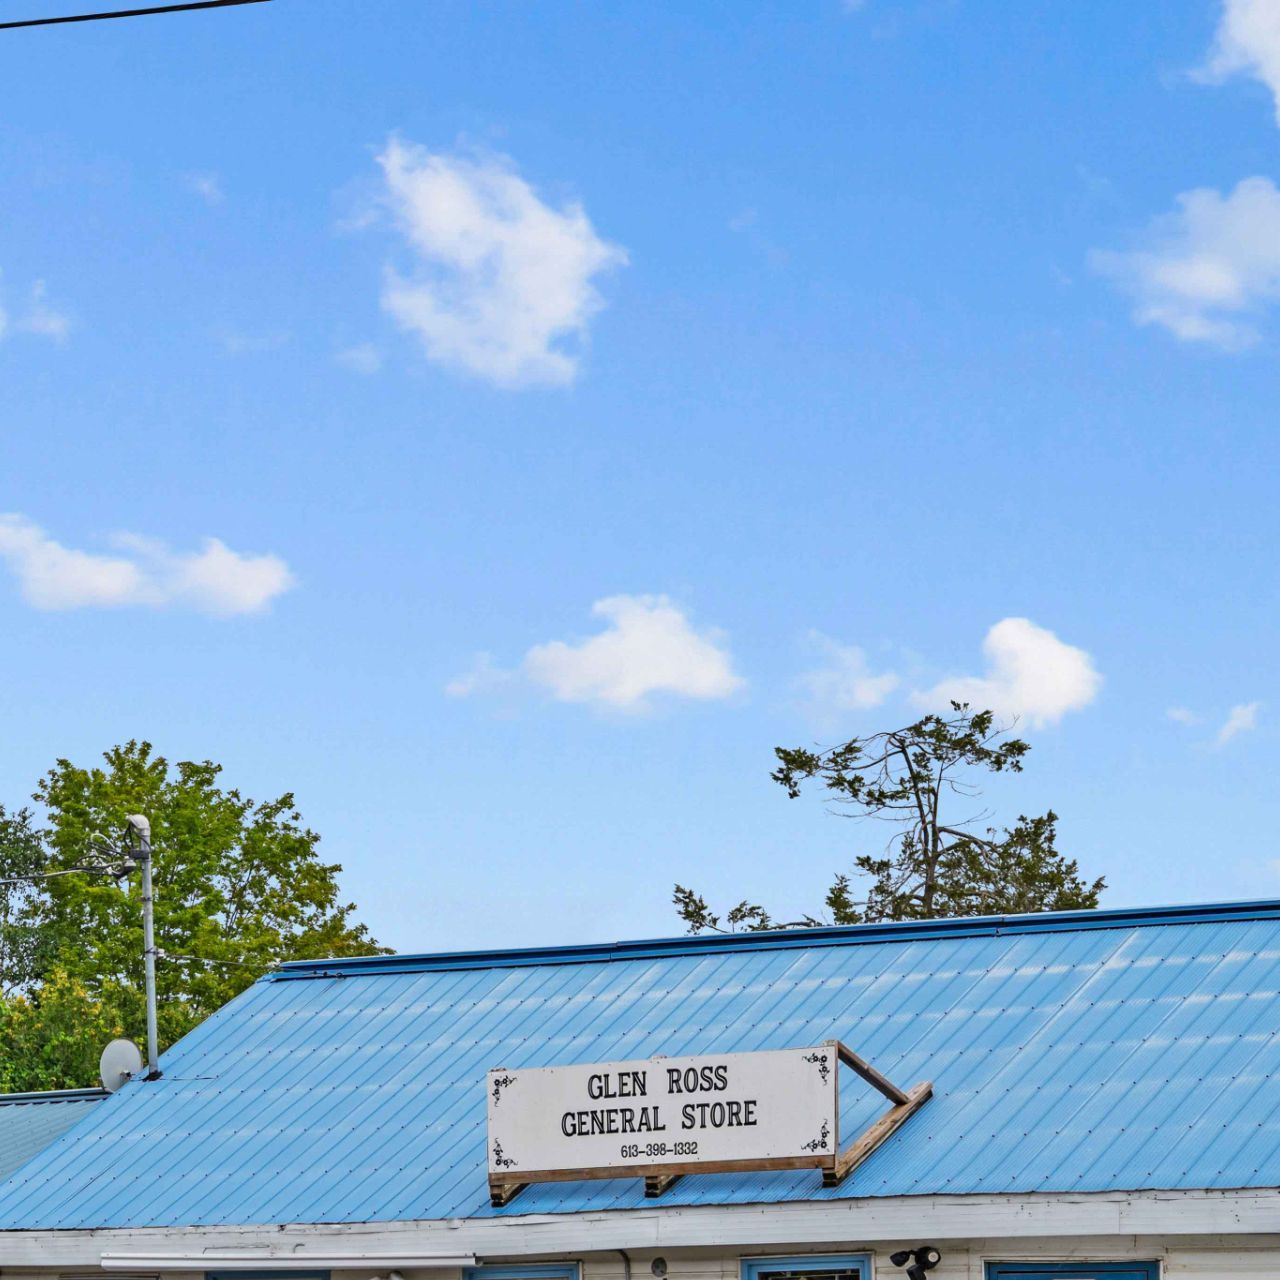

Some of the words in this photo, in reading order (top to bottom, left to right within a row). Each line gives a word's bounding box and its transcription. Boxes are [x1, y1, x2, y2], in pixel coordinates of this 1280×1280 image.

[587, 1072, 647, 1100] GLEN
[668, 1065, 729, 1094] ROSS
[561, 1106, 666, 1137] GENERAL
[681, 1100, 758, 1130] STORE
[620, 1141, 699, 1158] 613-398-1332
